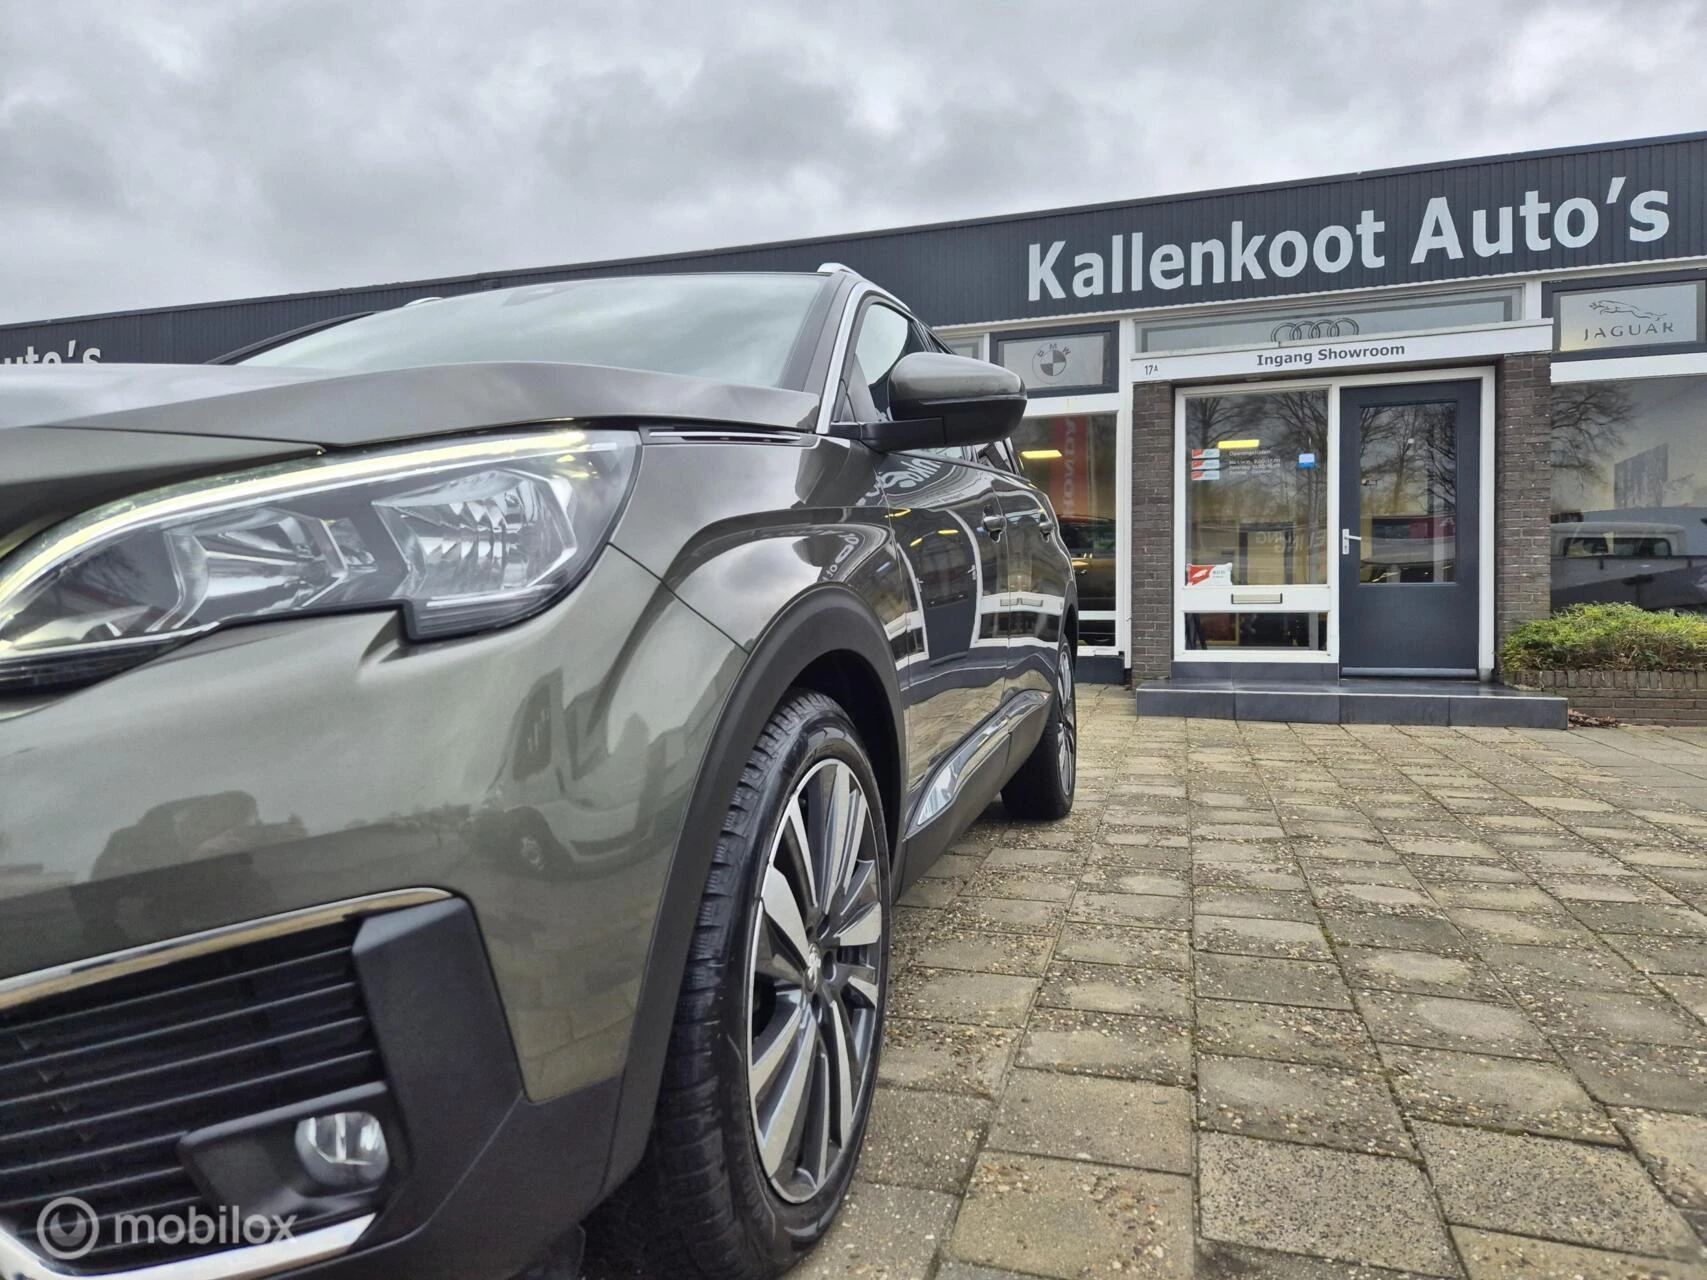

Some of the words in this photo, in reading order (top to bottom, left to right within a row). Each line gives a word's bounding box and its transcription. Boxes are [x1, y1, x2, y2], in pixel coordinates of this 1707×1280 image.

[1028, 209, 1385, 301] Kallenkoot
[1410, 176, 1670, 264] Auto's
[1584, 321, 1675, 341] JAGUAR
[1256, 353, 1313, 367] Ingang
[1318, 345, 1405, 361] Showroom
